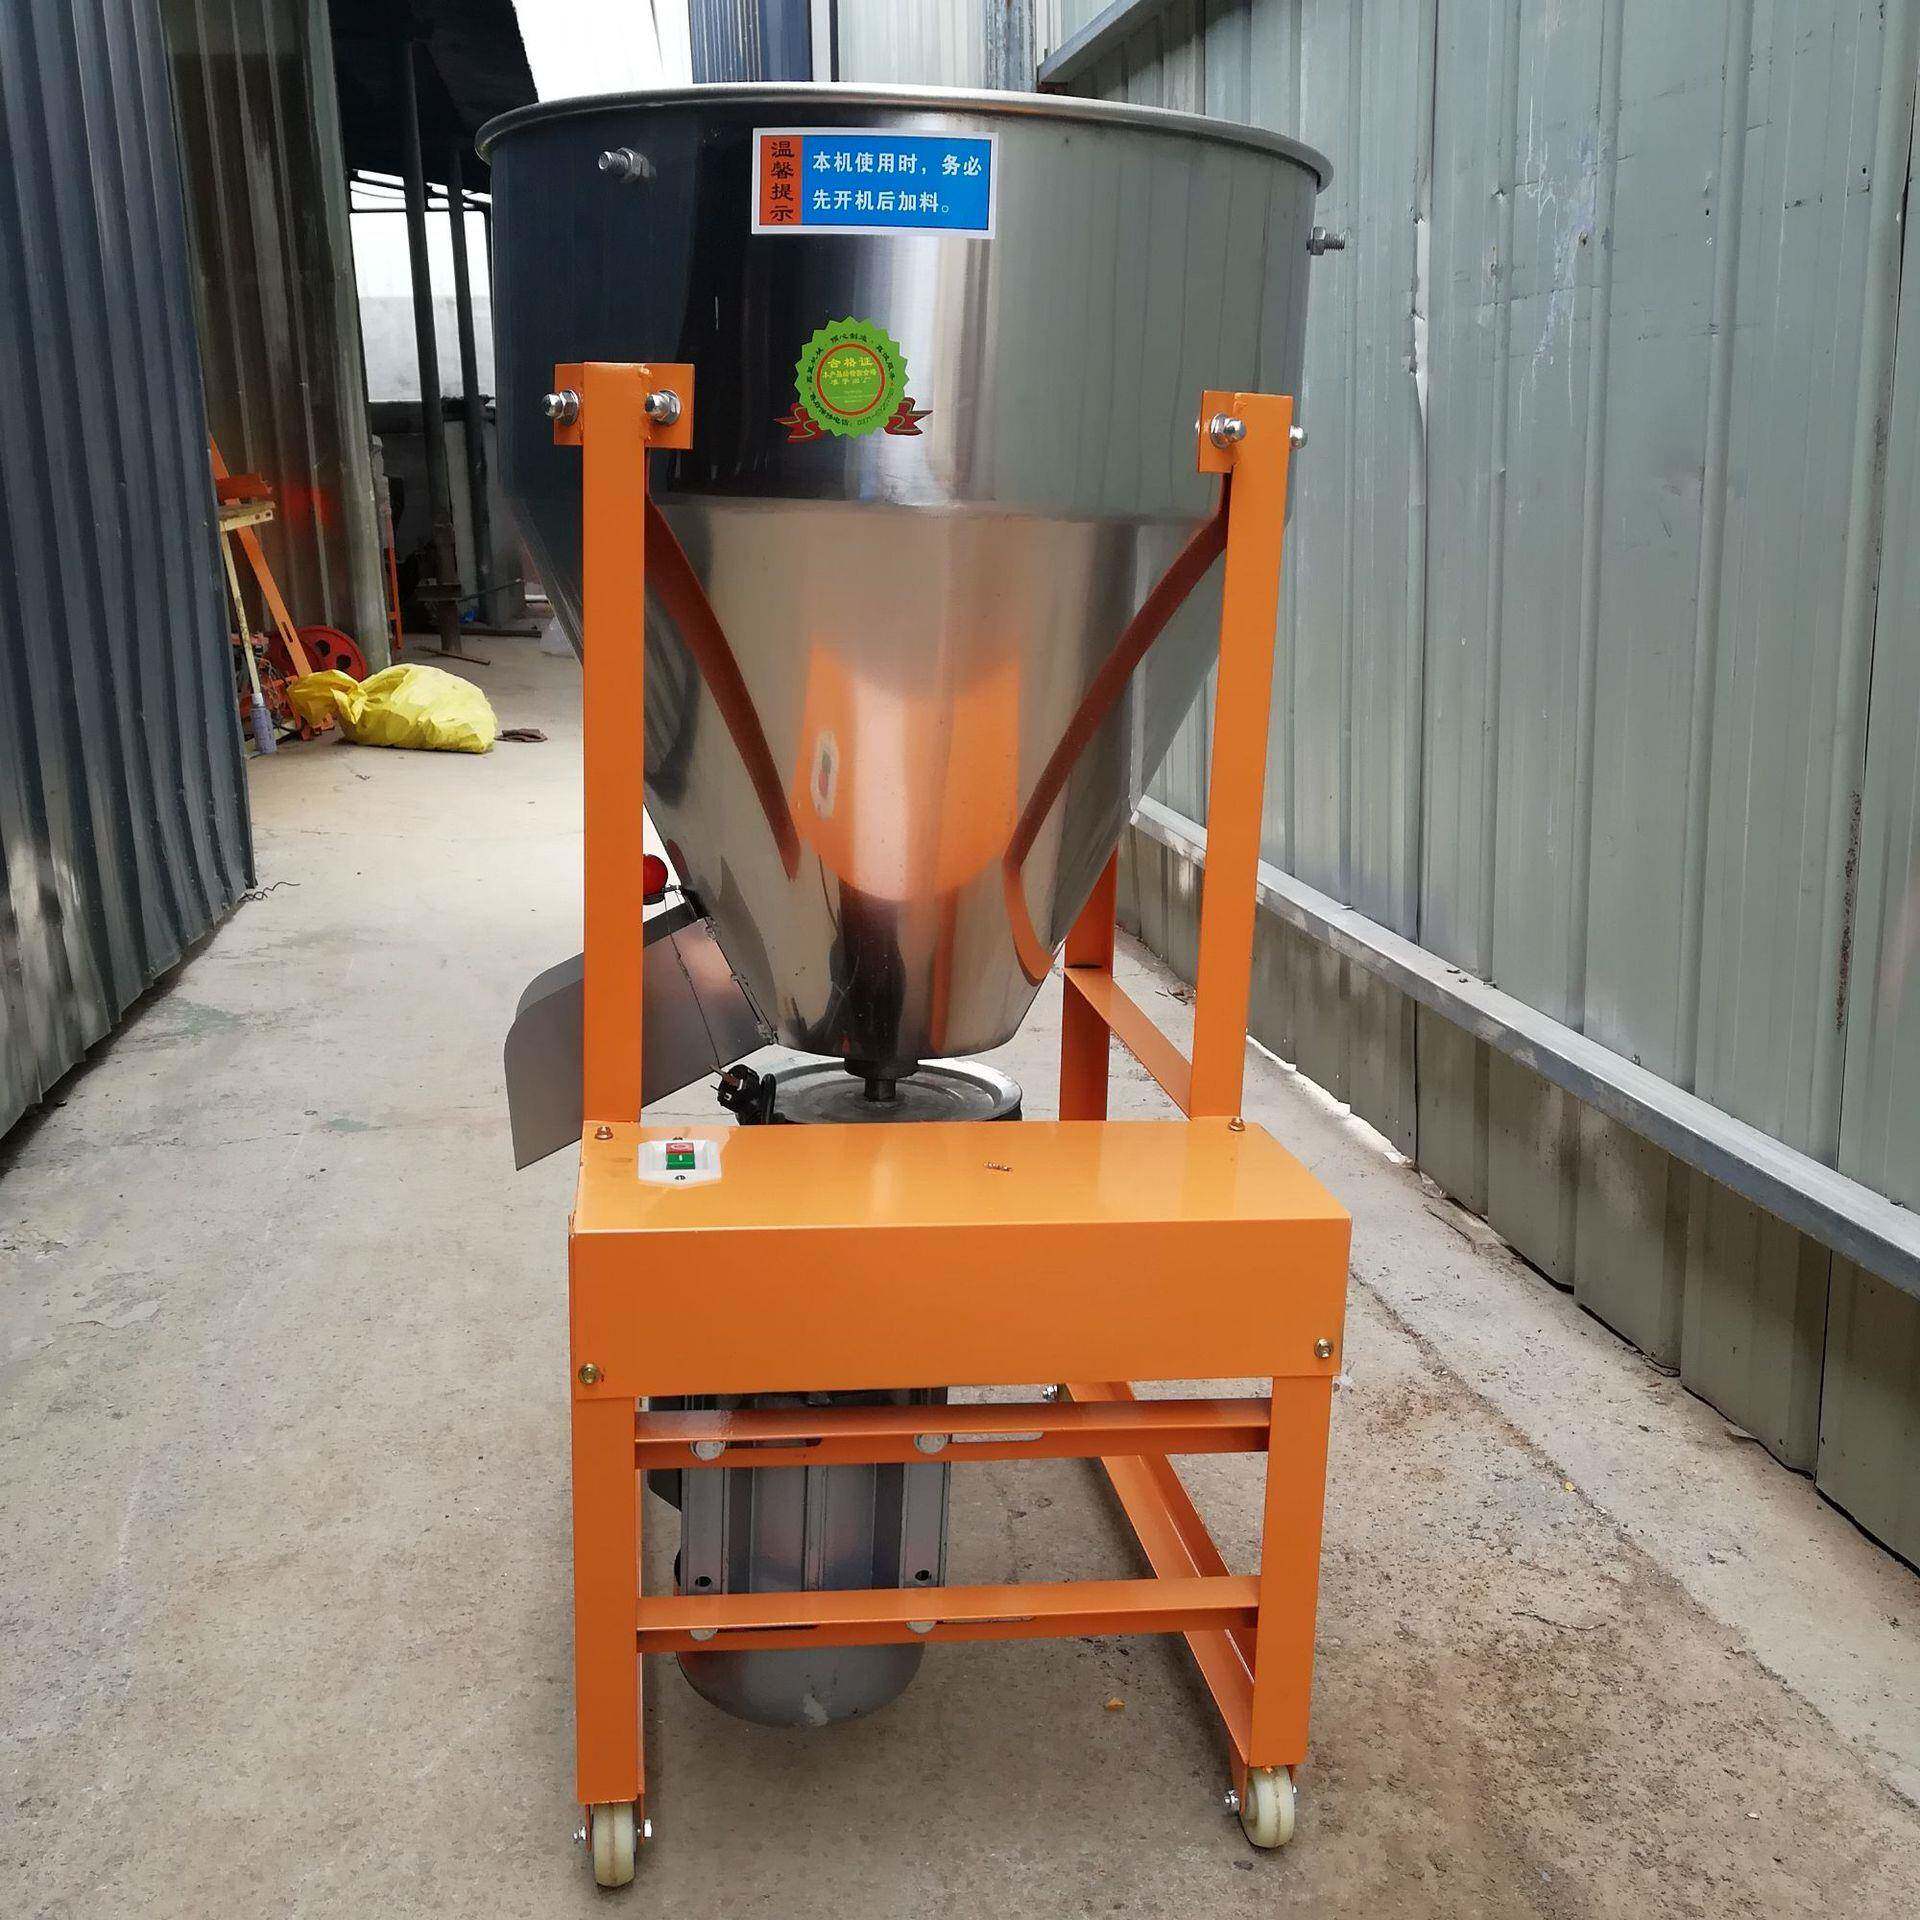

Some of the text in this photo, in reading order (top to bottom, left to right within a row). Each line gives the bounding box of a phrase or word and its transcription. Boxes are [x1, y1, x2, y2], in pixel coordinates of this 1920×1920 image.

[812, 151, 982, 176] 本机使用时，务必
[770, 140, 795, 221] 温馨提示
[812, 190, 949, 213] 先开机后加料。
